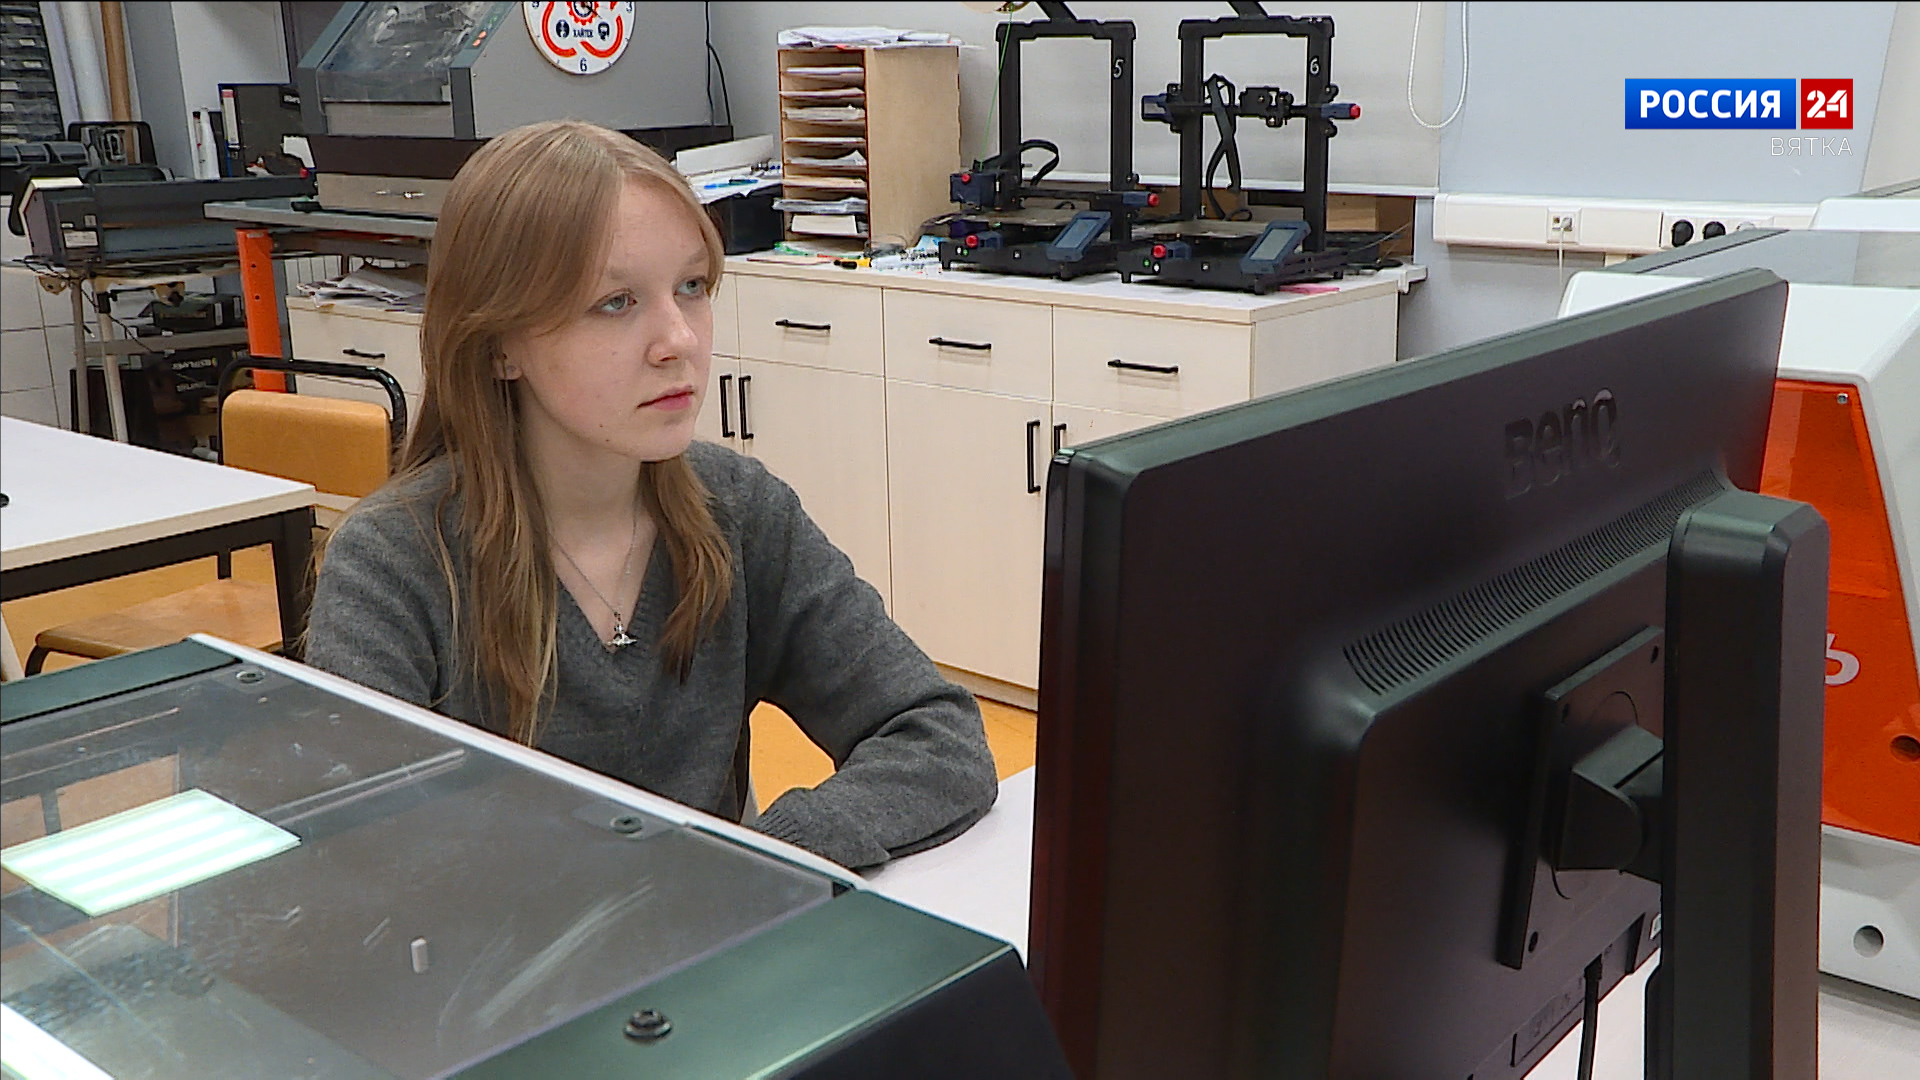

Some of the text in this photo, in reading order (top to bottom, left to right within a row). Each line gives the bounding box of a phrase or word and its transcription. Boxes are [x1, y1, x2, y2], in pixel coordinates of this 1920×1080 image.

[579, 57, 588, 72] 6
[1113, 58, 1124, 78] 5
[1310, 57, 1320, 75] 6
